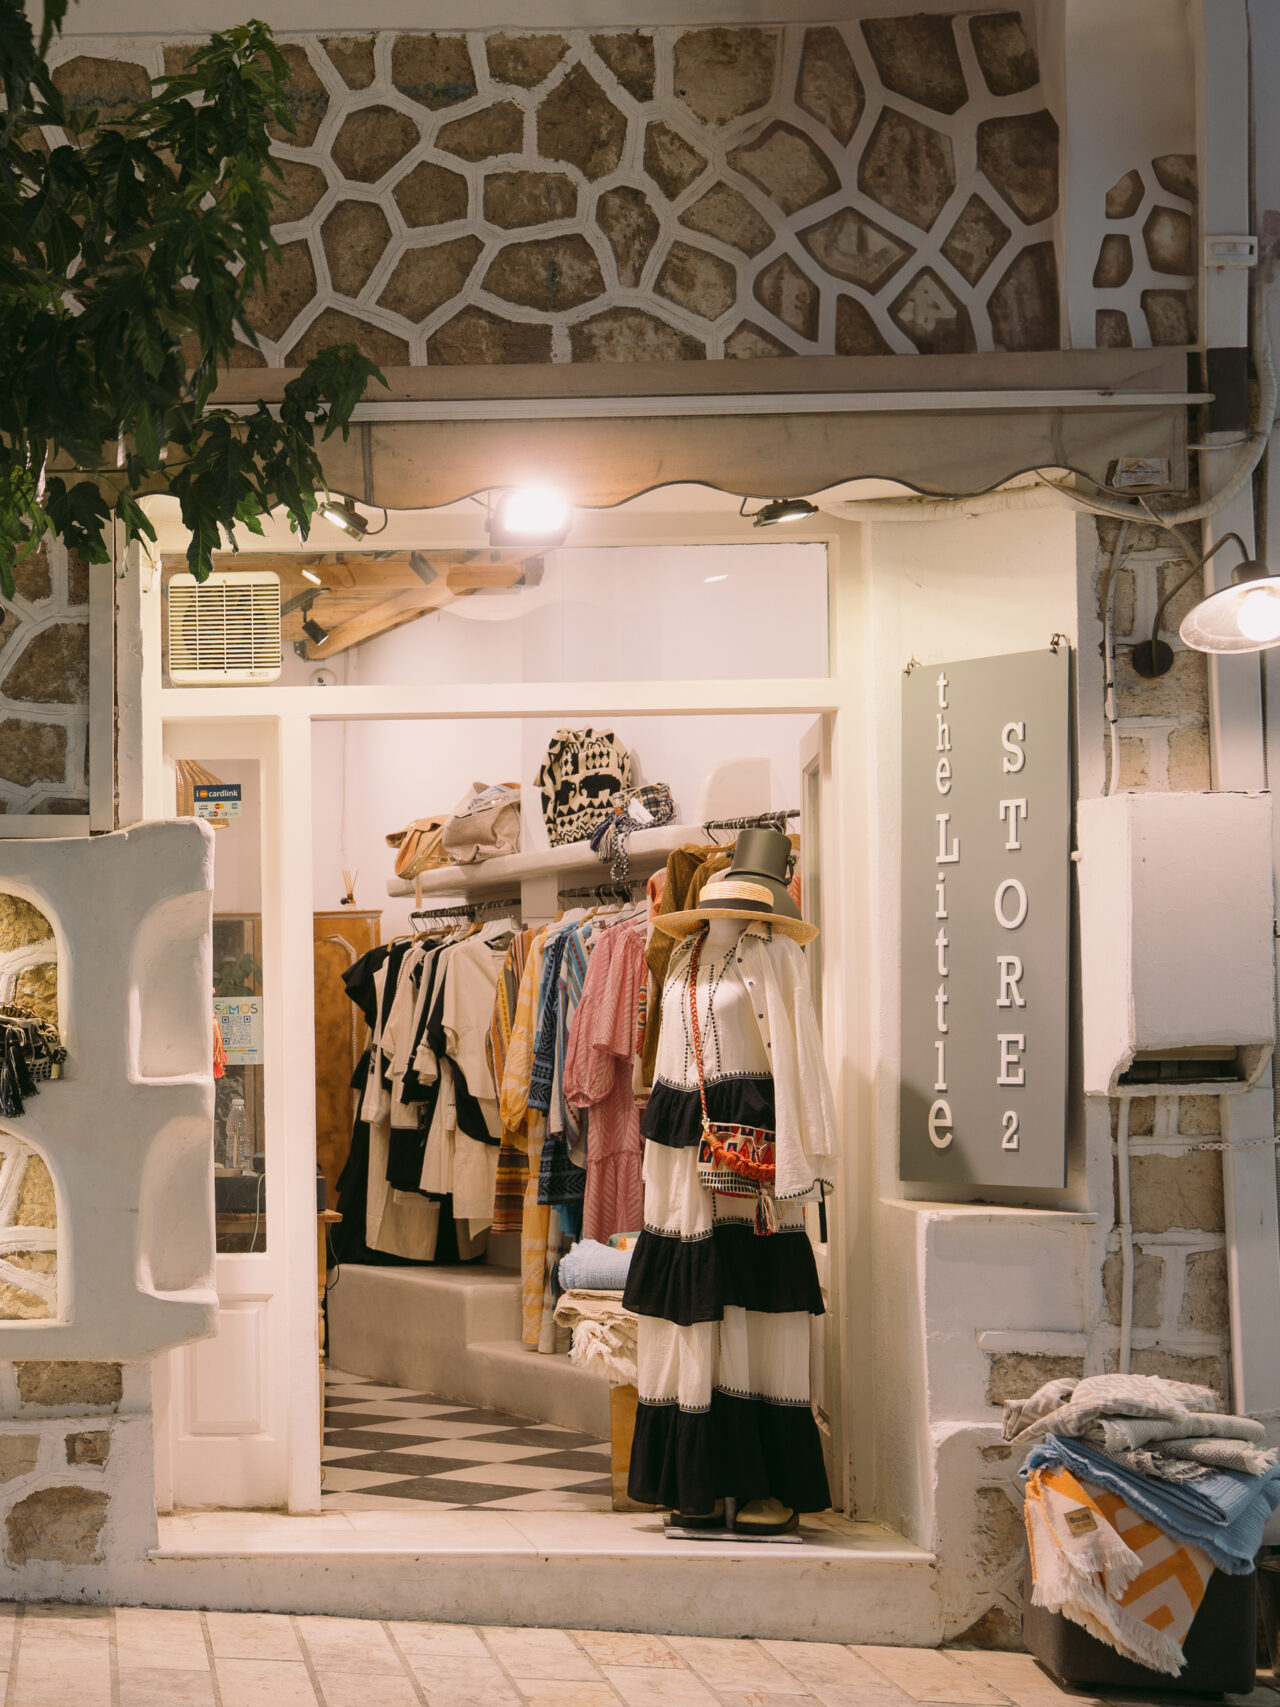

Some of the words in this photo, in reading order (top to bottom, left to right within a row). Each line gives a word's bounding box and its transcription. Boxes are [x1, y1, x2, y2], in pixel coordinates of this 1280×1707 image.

[935, 672, 952, 795] the
[208, 790, 238, 798] cardlink
[995, 721, 1028, 1085] STORE
[215, 1003, 258, 1015] SAMOS
[928, 813, 960, 1149] Little
[1002, 1111, 1020, 1149] 2
